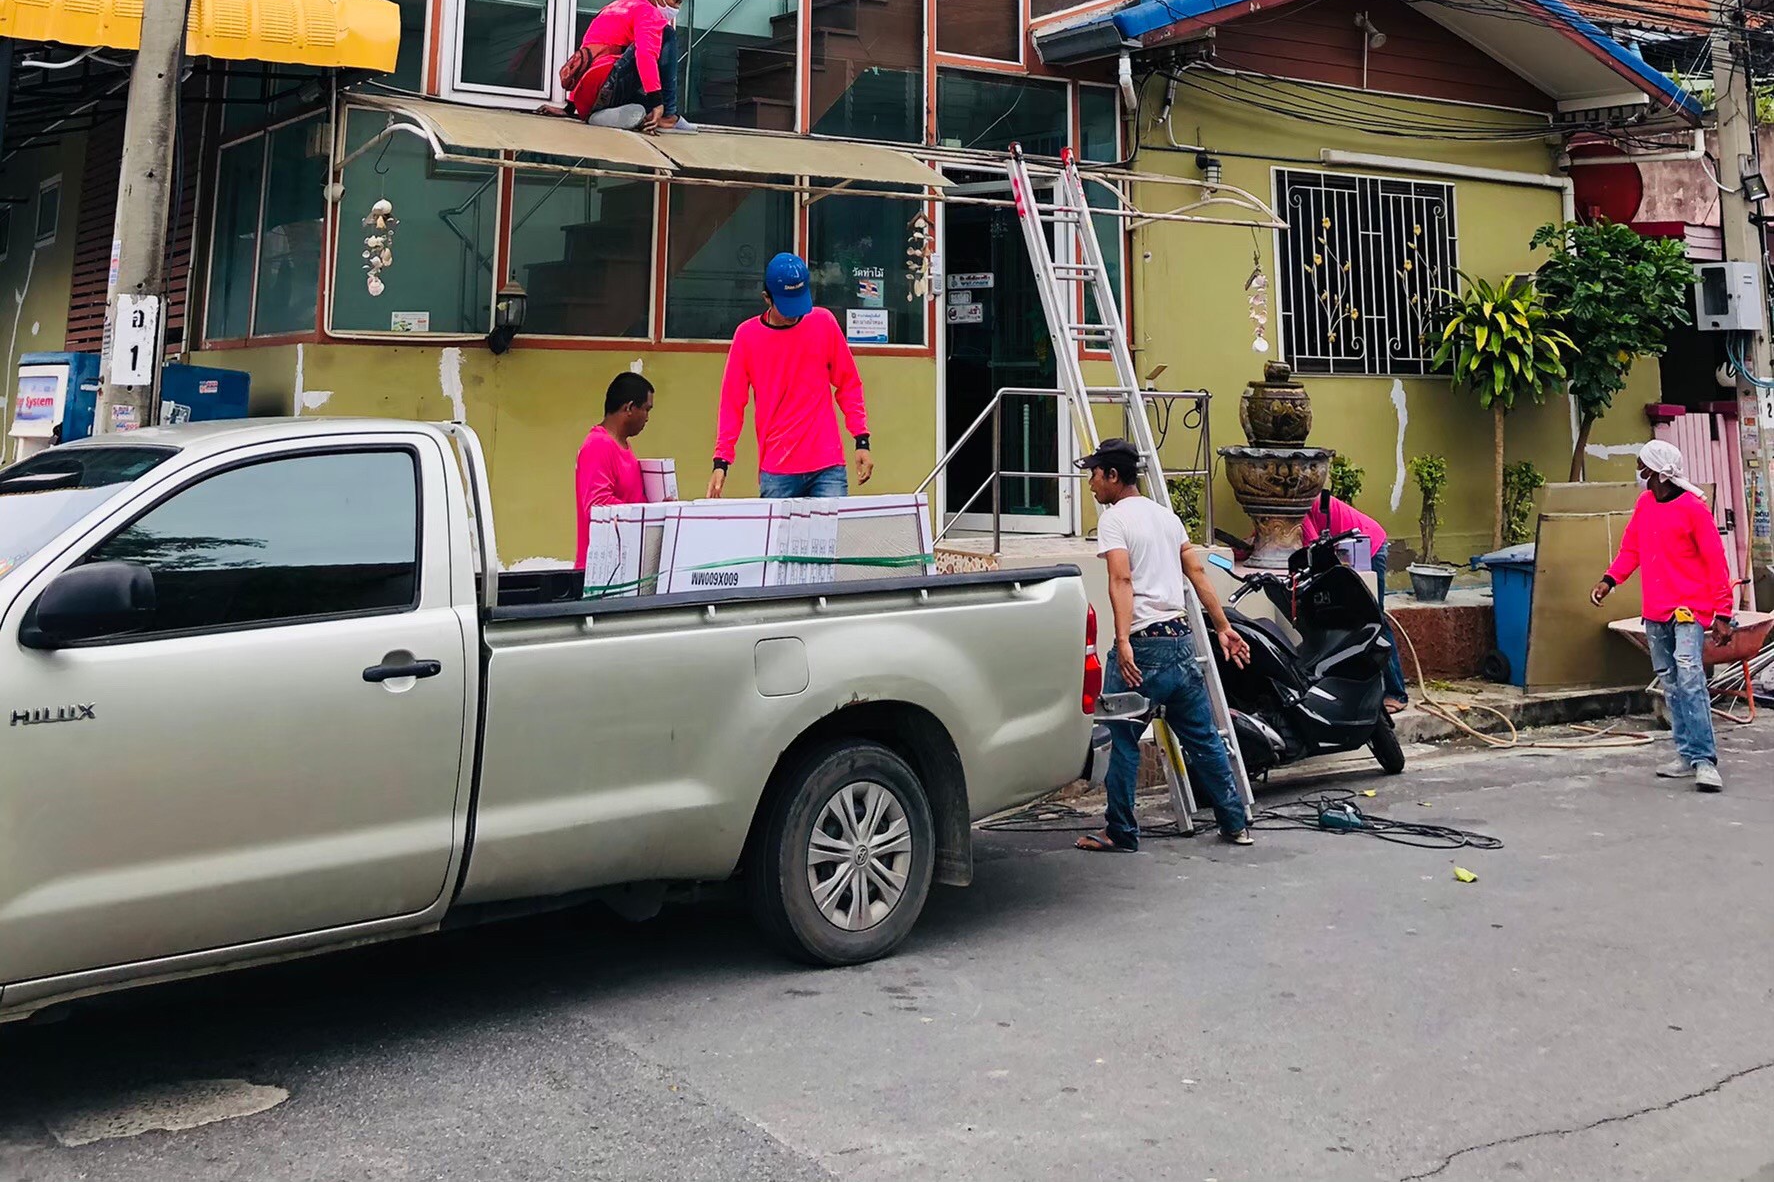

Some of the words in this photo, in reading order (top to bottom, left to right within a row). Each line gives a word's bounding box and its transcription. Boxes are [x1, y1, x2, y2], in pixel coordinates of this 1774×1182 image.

[130, 344, 139, 372] 1
[26, 396, 54, 409] System
[1767, 402, 1773, 419] 2
[10, 701, 96, 726] HILUX
